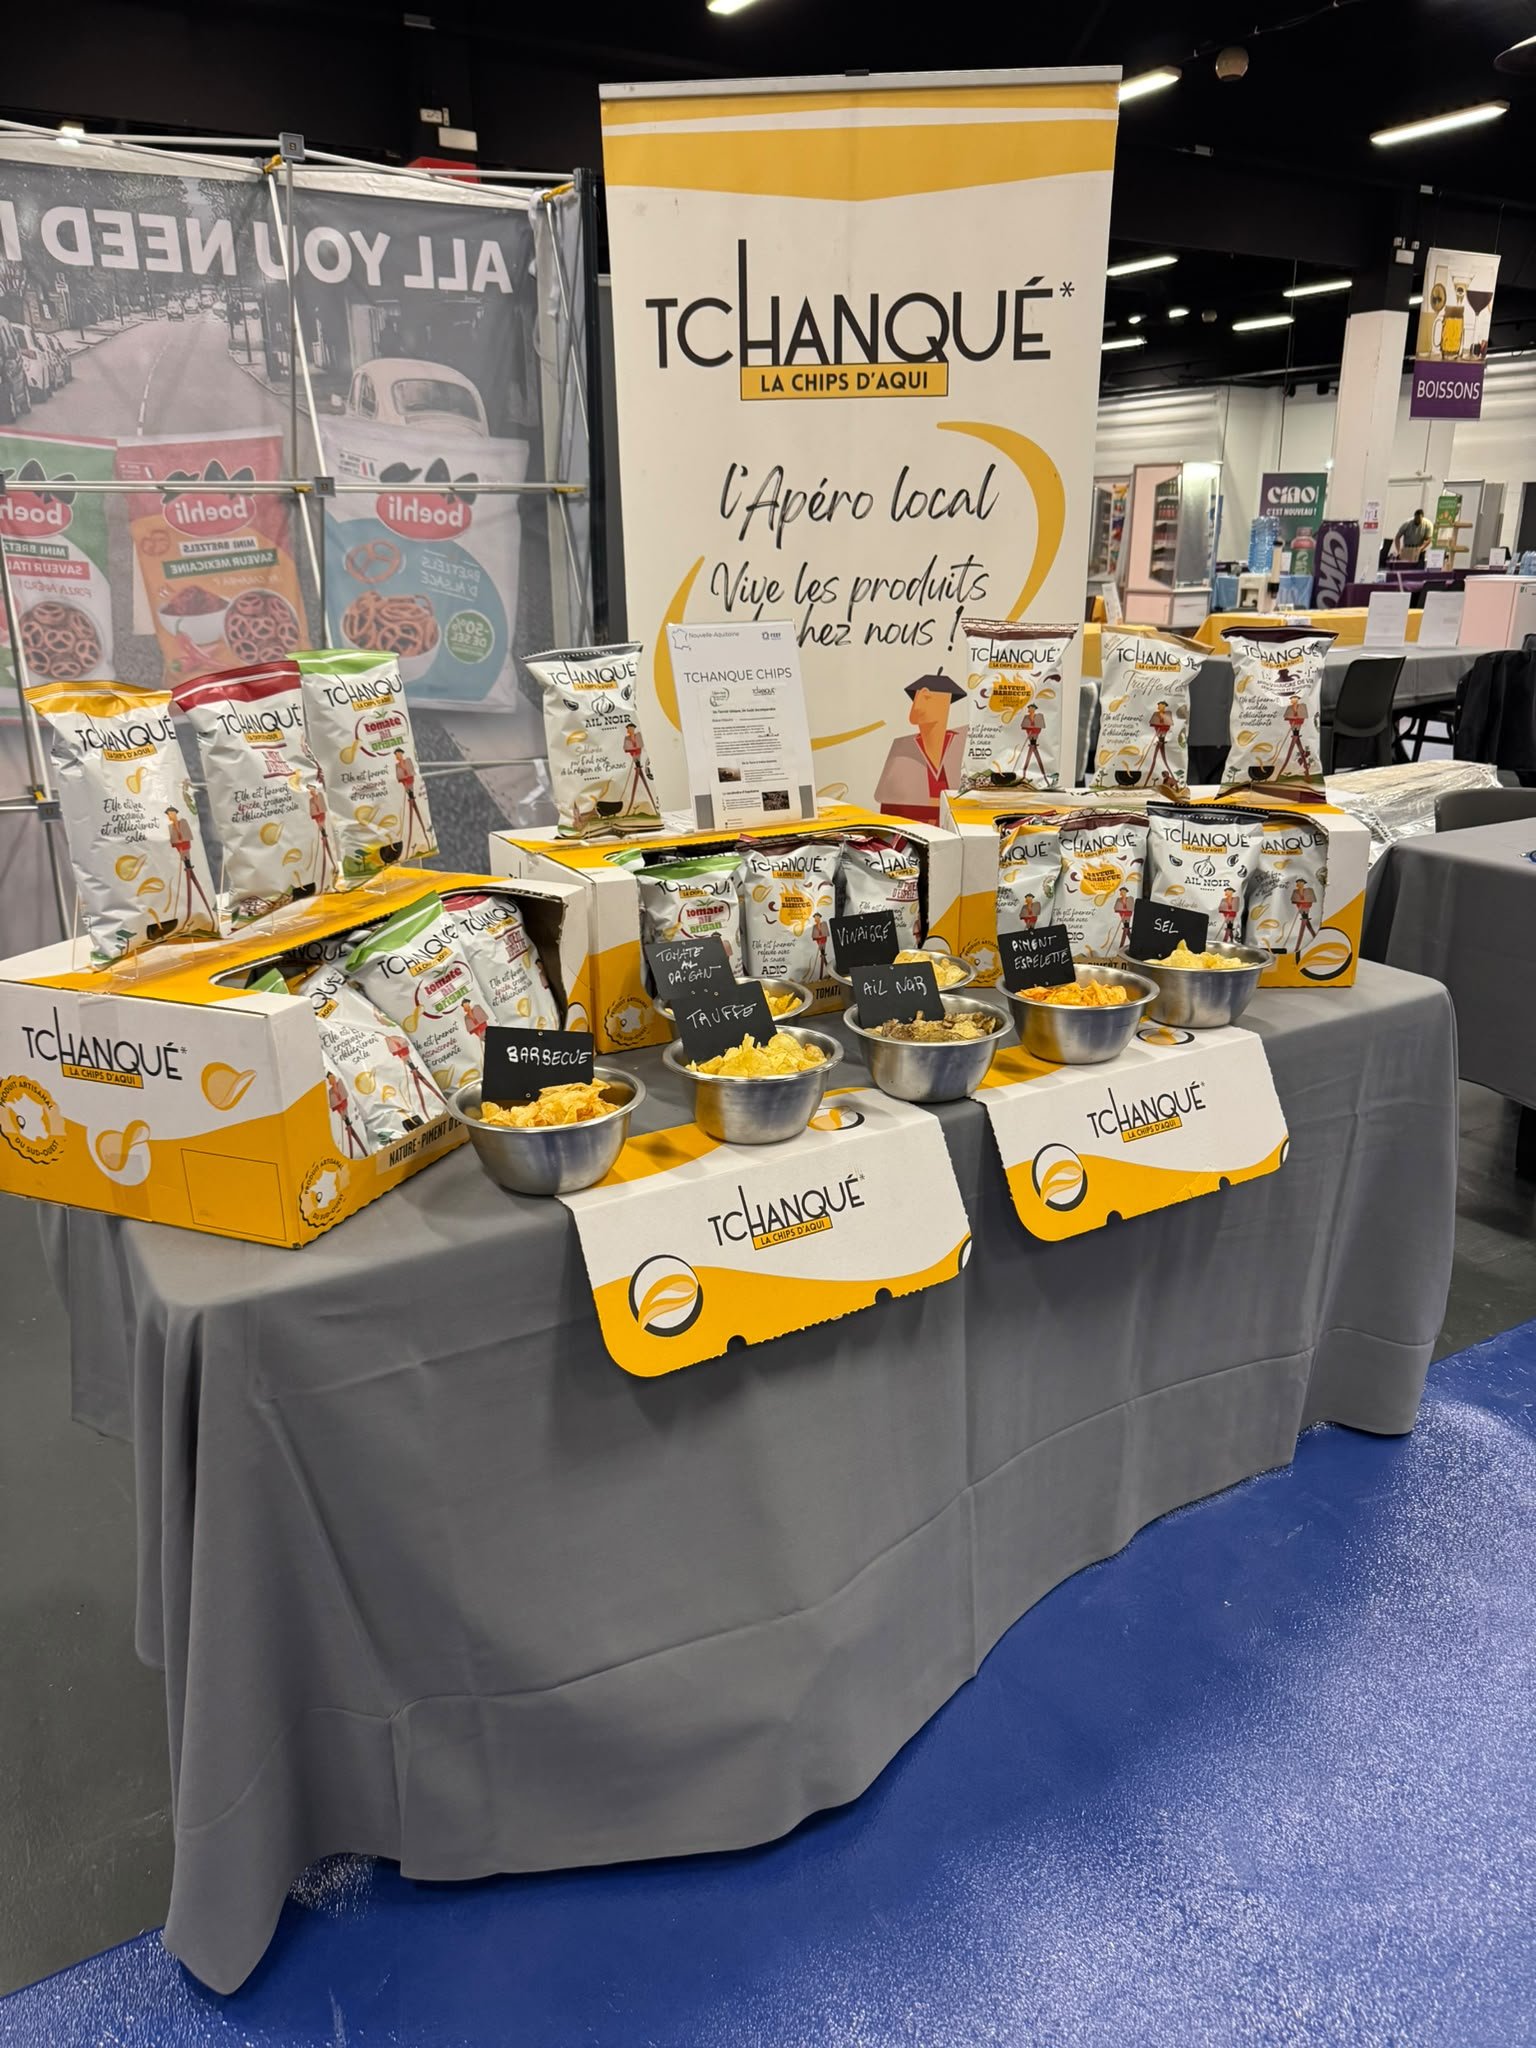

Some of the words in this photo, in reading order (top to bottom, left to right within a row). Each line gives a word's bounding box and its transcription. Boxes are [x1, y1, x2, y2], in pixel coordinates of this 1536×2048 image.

[761, 374, 784, 393] LA
[791, 373, 850, 392] CHIPS
[856, 371, 928, 392] D'AQUI
[1416, 379, 1480, 400] BOISSONS
[890, 463, 1000, 523] local
[1266, 507, 1283, 516] C'EST
[1283, 507, 1313, 517] NOUVEAU
[710, 560, 785, 613] Vive
[794, 562, 840, 605] les
[847, 554, 990, 623] produits
[797, 603, 851, 648] hez
[863, 617, 936, 648] nous
[946, 605, 965, 652] !
[970, 640, 1061, 664] TCHANQUÉ
[547, 660, 638, 686] TCHANQUÉ
[684, 669, 754, 683] TCHANQUE
[756, 667, 793, 680] CHIPS
[322, 673, 402, 707] TCHANQU
[216, 697, 303, 735] TCHANQUÉ
[364, 716, 402, 733] tomate
[585, 717, 603, 729] AIL
[604, 714, 632, 725] NOIR
[74, 712, 177, 752] TCHANQUÉ
[968, 747, 993, 757] ADIO
[1059, 829, 1138, 853] CHANQUÉ
[1162, 820, 1250, 848] TCHANQUÉ
[1261, 832, 1326, 851] ANQUÉ
[1084, 874, 1122, 882] BARBECUE
[1184, 876, 1201, 886] AIL
[1203, 878, 1231, 887] NOIR
[687, 905, 725, 918] tomate
[1153, 917, 1179, 934] SEL
[1011, 935, 1057, 953] PIMENT
[1067, 932, 1084, 941] DIO
[1013, 947, 1071, 970] ESPELETTE
[761, 964, 788, 975] ADIO
[424, 966, 463, 996] tomate
[434, 985, 469, 1013] origan
[506, 1045, 592, 1066] BARBECUE
[69, 1066, 81, 1077] LA
[81, 1069, 104, 1080] CHIPS
[105, 1073, 136, 1086] D'AQUI
[18, 1080, 54, 1111] ARTISANAL
[1127, 1131, 1137, 1139] LA
[1136, 1126, 1155, 1137] CHIPS
[1154, 1119, 1177, 1132] D'AQUI
[14, 1137, 26, 1149] DU
[26, 1139, 59, 1157] SUD-OUEST
[388, 1140, 417, 1168] NATURE
[420, 1123, 447, 1148] PIMENT
[304, 1164, 321, 1195] PRODUIT
[760, 1236, 771, 1246] LA
[772, 1229, 796, 1242] CHIPS
[797, 1220, 826, 1236] D'AQUI
